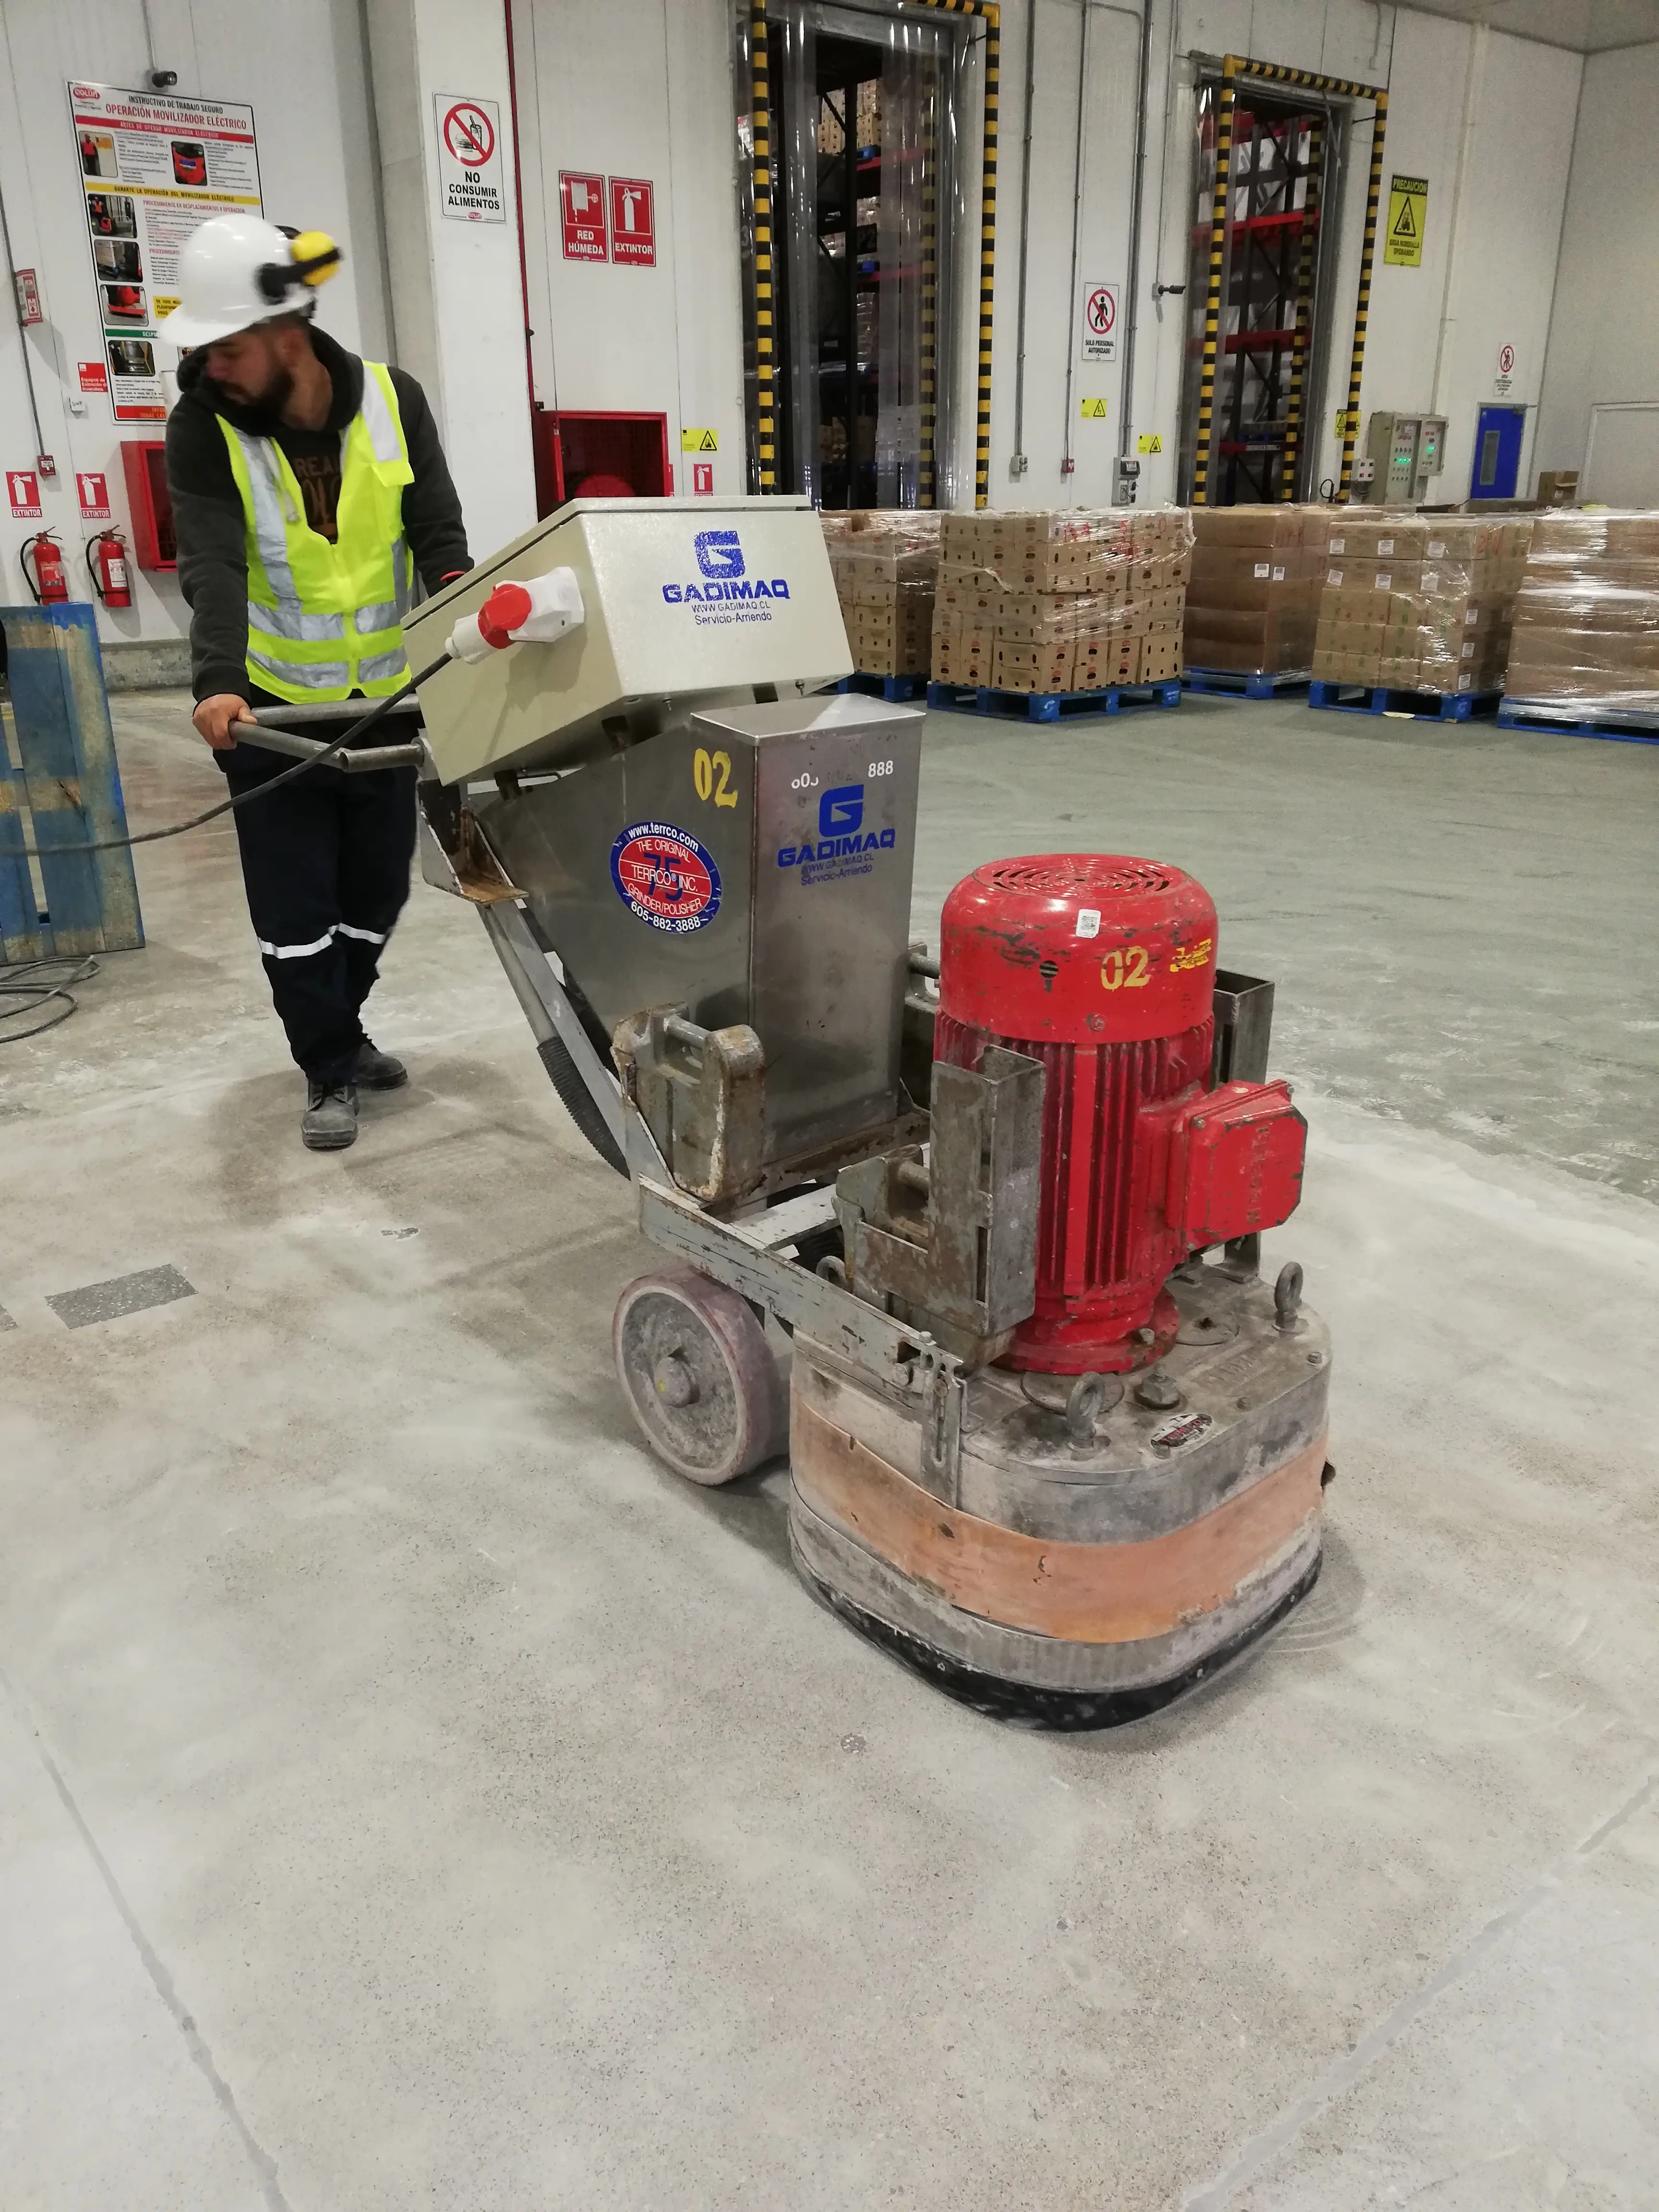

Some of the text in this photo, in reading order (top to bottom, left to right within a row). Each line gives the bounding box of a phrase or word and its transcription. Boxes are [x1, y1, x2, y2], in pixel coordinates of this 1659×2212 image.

[129, 96, 223, 114] INSTRUCTIVO DE TRABAJO SEGURO
[106, 103, 151, 119] OPERACIÓN
[153, 109, 205, 125] MOVILIZADOR
[207, 115, 247, 130] ELÉCTRICO
[465, 171, 480, 183] NO
[449, 183, 497, 198] CONSUMIR
[448, 196, 500, 210] ALIMENTOS
[577, 230, 594, 240] RED
[568, 241, 604, 255] HÚMEDA
[614, 242, 653, 255] EXTINTOR
[662, 579, 791, 603] GADIMAQ
[695, 611, 772, 625] Servicio-Arriendo
[694, 748, 738, 808] 02
[868, 760, 893, 778] 888
[628, 821, 699, 853] www.terrco.com
[636, 839, 691, 863] THE ORIGINAL
[778, 828, 896, 867] GADIMAQ
[679, 875, 698, 892] INC.
[628, 883, 703, 915] GRINDER/POLISHER
[631, 901, 701, 932] 605-882-3888
[1101, 946, 1151, 992] 02
